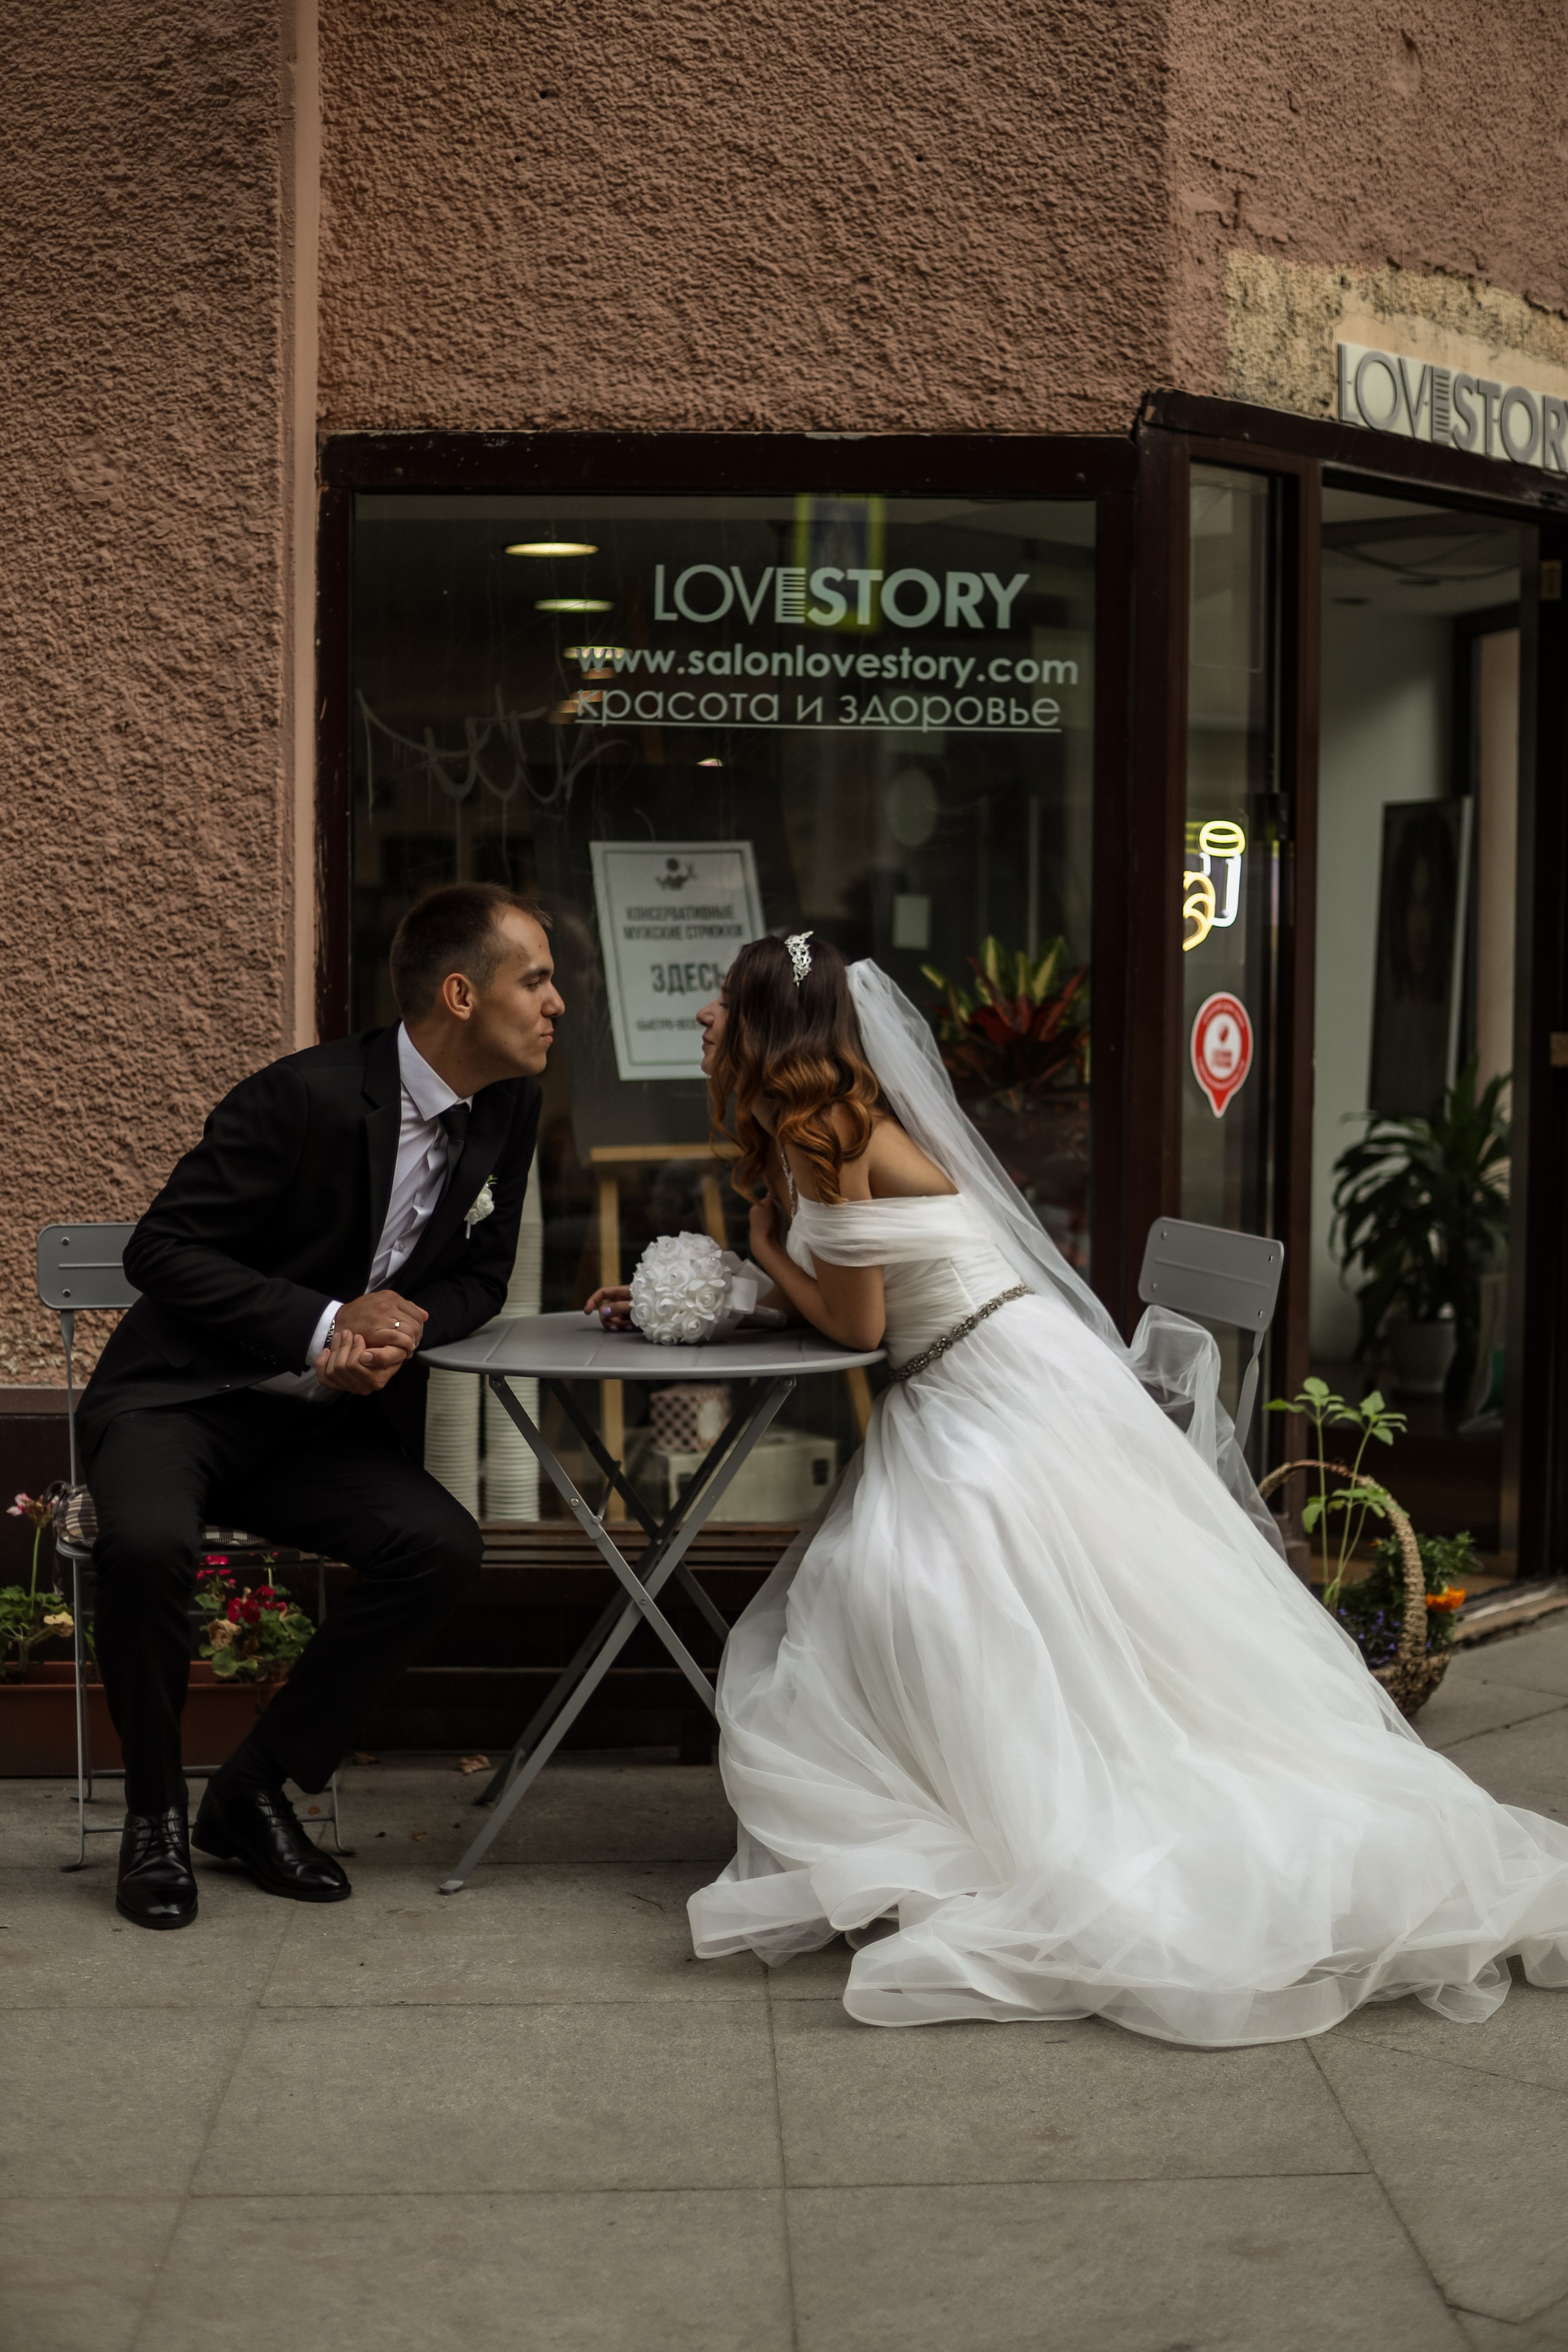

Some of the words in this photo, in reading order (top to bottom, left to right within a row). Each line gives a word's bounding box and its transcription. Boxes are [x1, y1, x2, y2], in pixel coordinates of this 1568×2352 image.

[1338, 342, 1568, 473] LOVESTOR
[654, 564, 1030, 629] LOVESTORY
[576, 644, 1079, 688] www.salonlovestory.com
[577, 689, 779, 727] красота
[797, 695, 823, 722] и
[839, 694, 1061, 733] здоровье
